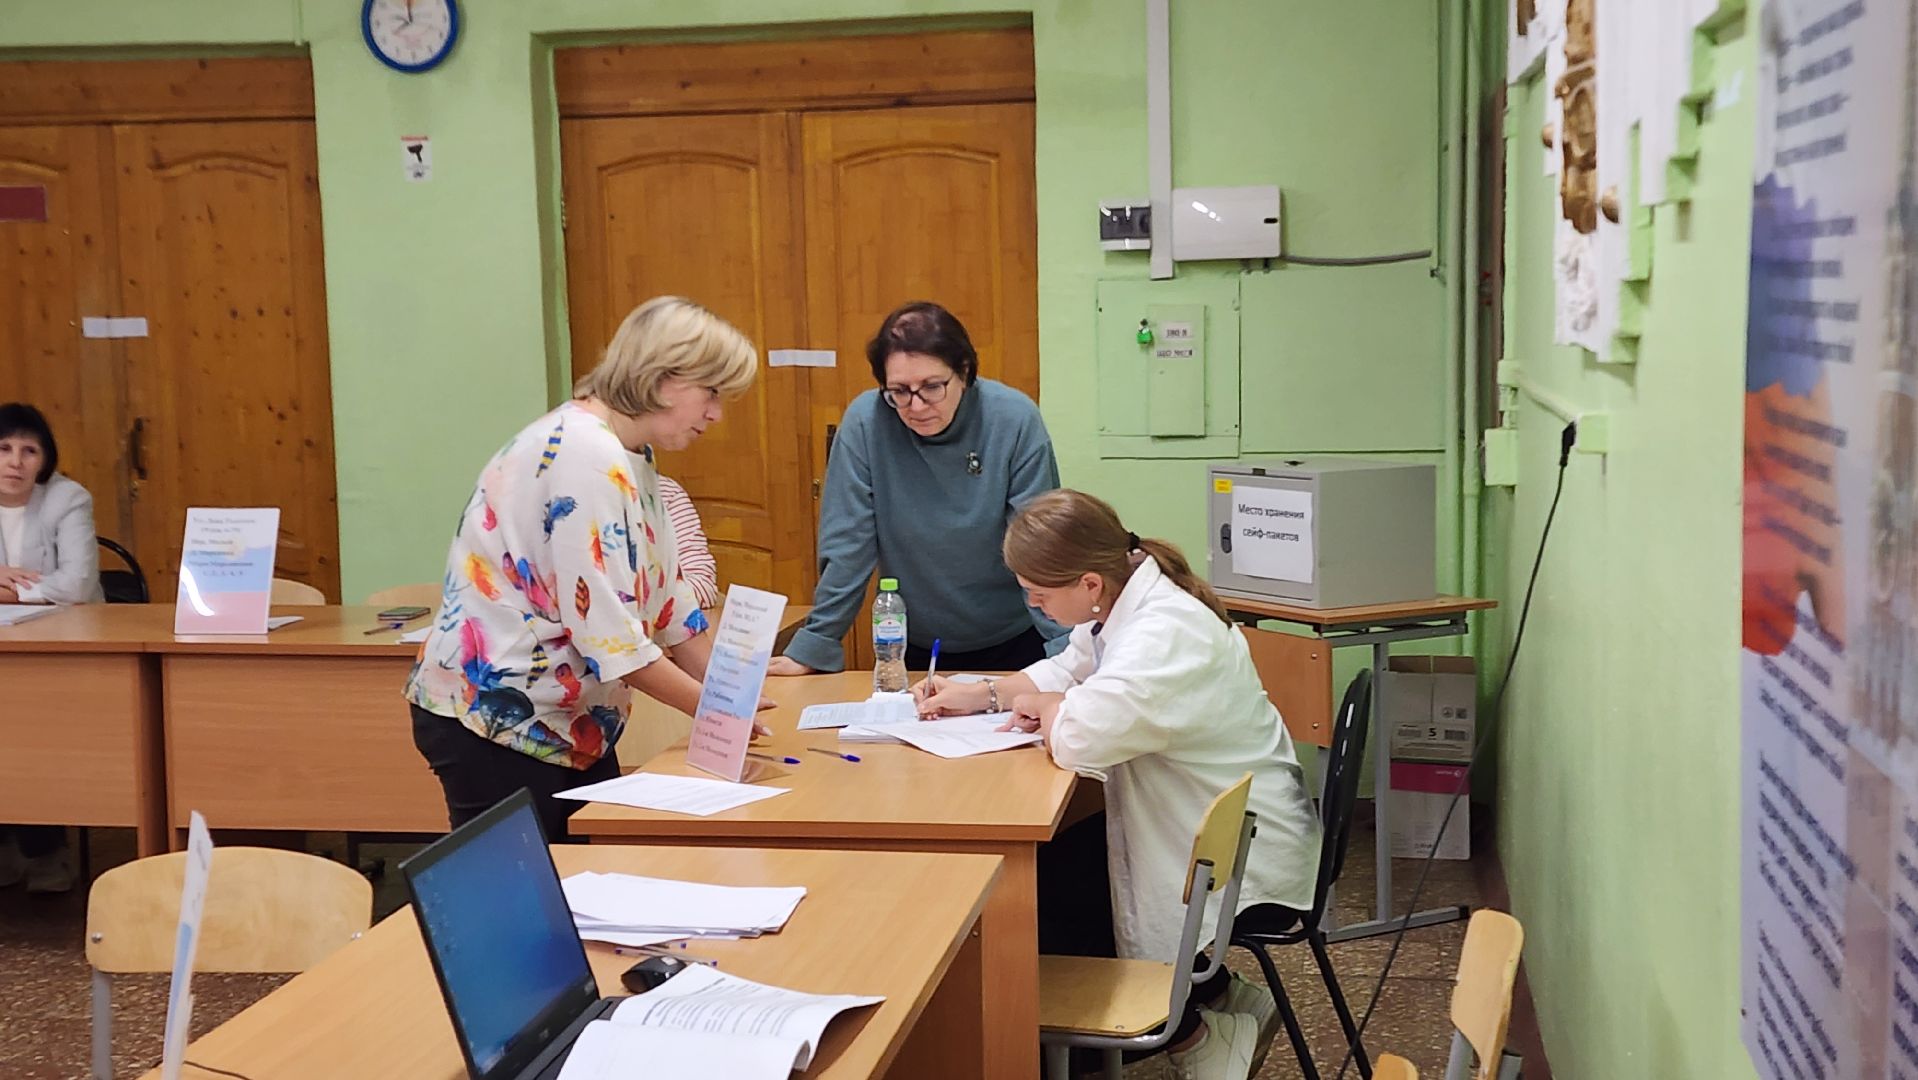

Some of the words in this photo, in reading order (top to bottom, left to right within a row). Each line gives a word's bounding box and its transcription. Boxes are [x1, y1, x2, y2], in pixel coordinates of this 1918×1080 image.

[1239, 504, 1263, 516] Место
[1266, 509, 1304, 519] хранения
[1244, 528, 1299, 542] сейф-пакетов
